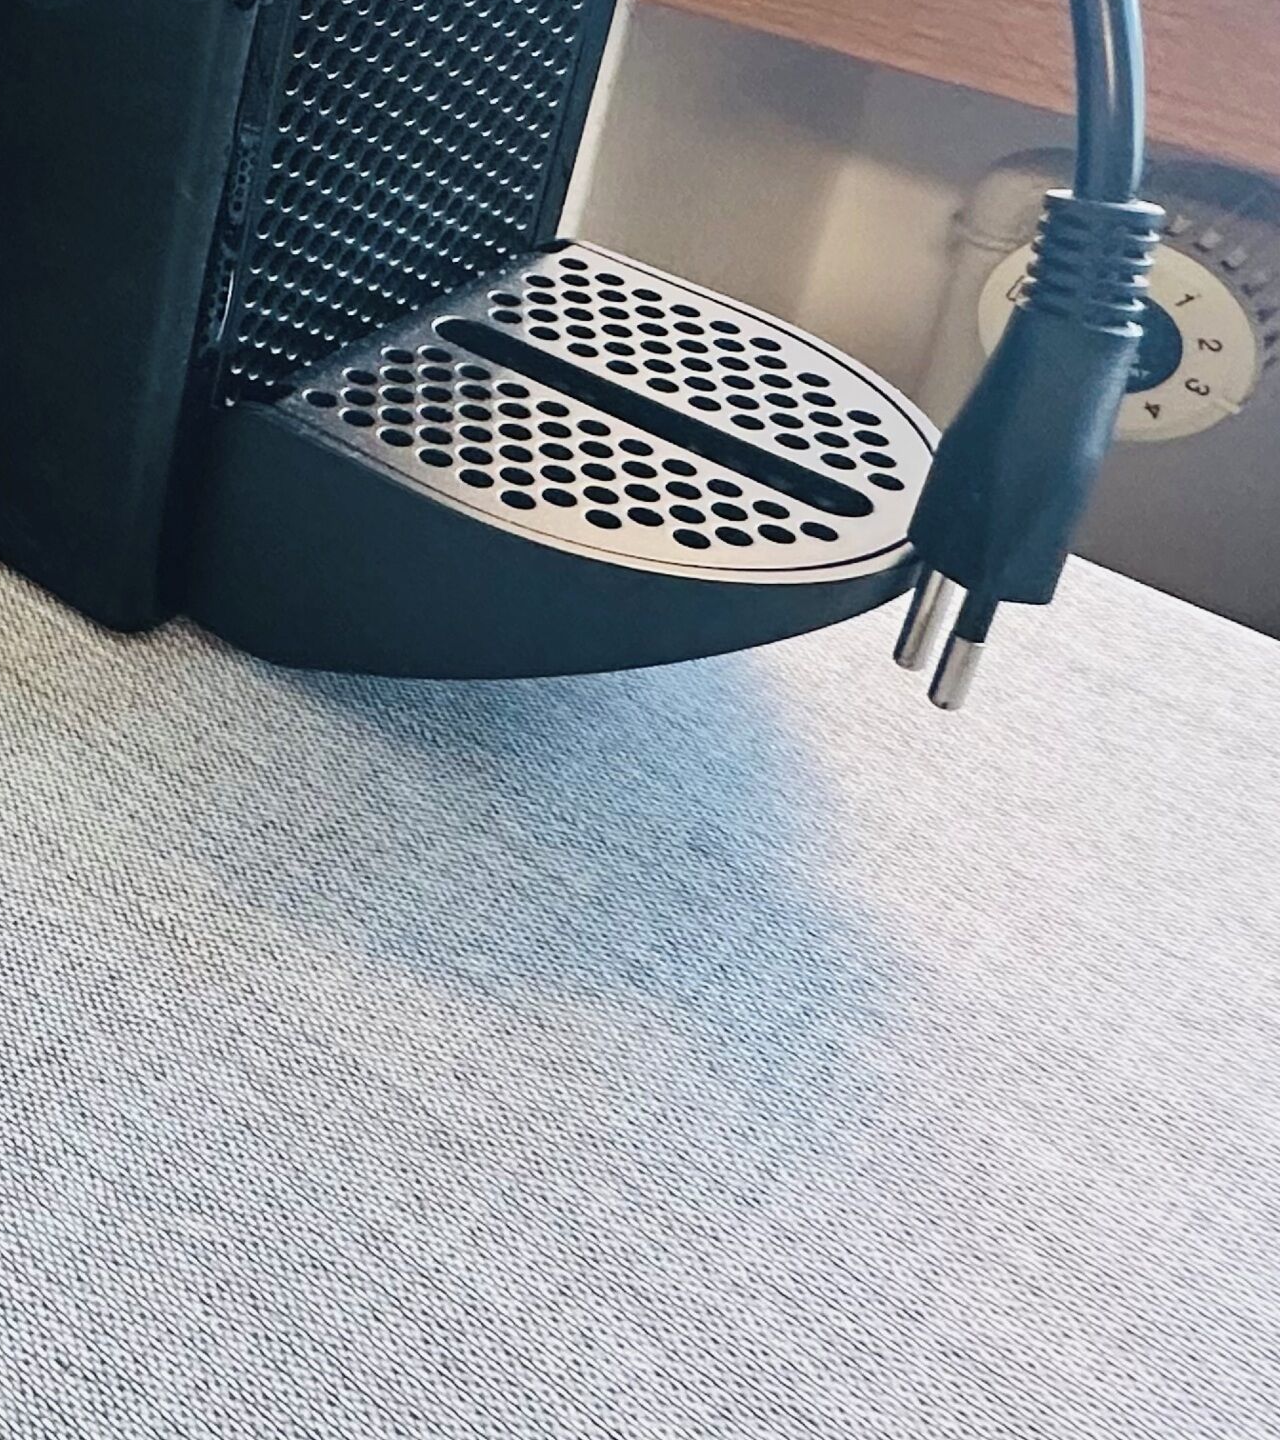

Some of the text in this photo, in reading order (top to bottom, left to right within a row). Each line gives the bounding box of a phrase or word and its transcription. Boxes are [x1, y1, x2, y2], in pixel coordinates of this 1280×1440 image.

[1175, 293, 1197, 307] 1
[1198, 337, 1224, 353] 2
[1184, 377, 1211, 397] 3
[1144, 400, 1161, 420] 4
